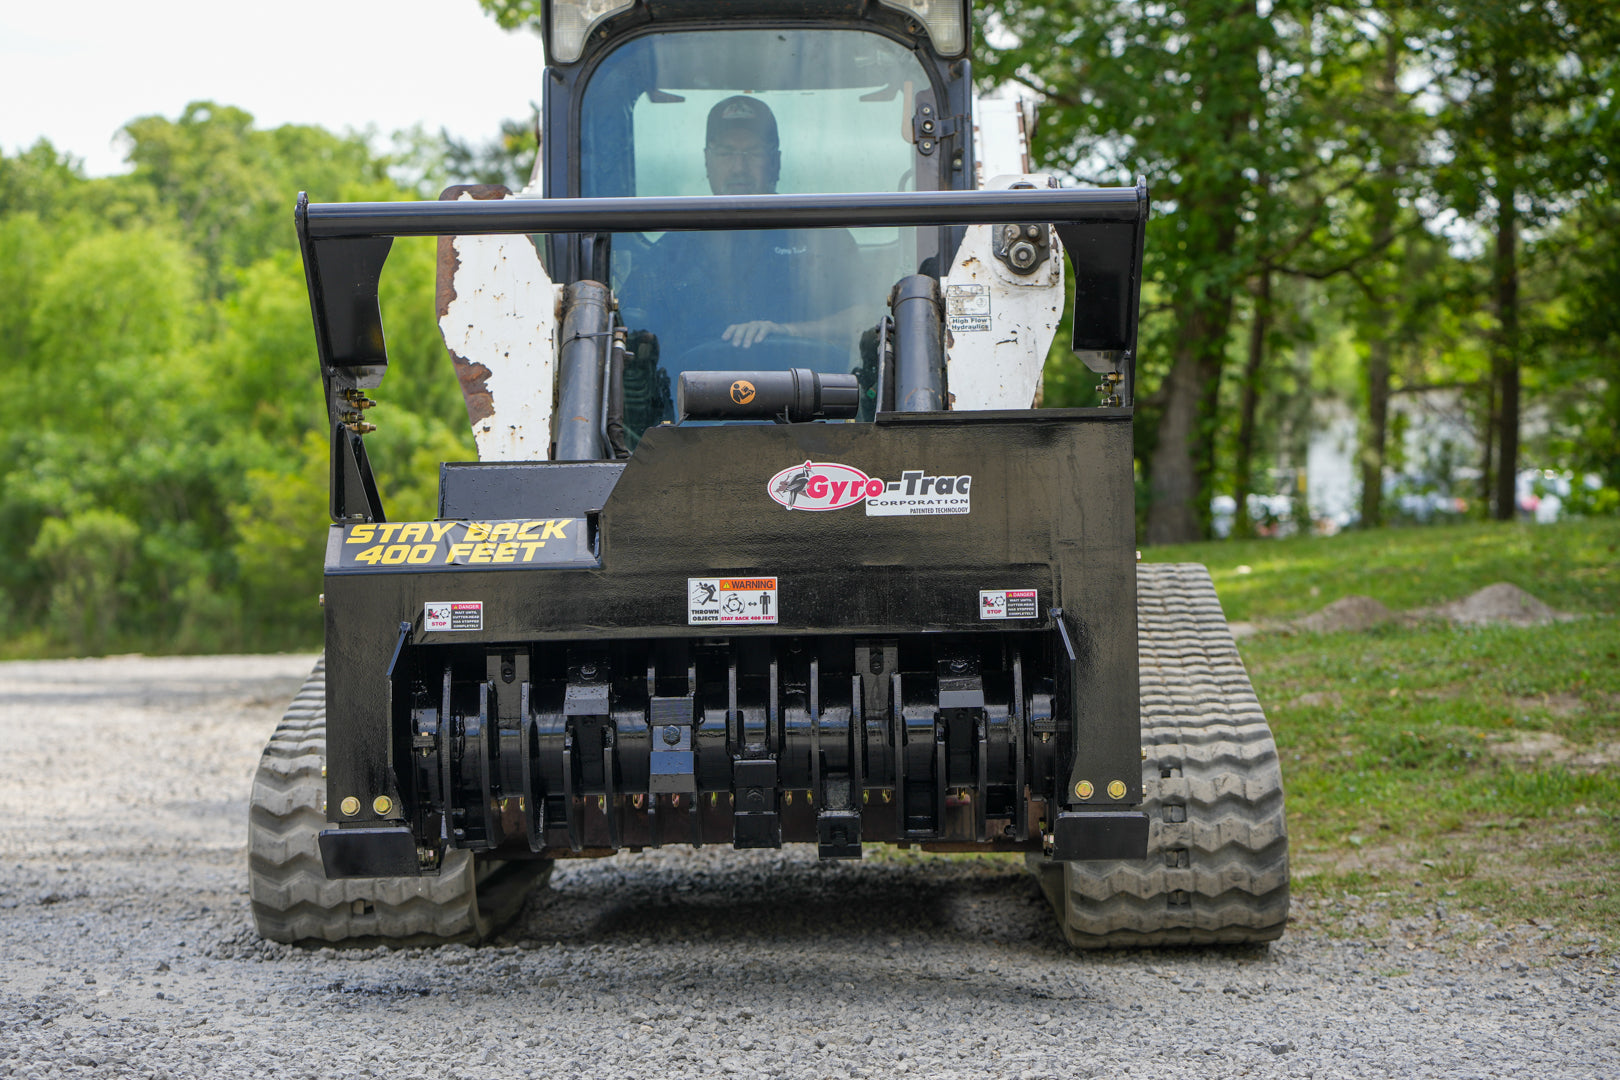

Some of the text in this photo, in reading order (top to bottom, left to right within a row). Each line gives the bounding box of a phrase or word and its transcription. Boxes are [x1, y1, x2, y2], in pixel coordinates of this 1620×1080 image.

[805, 471, 971, 505] Gyro-Trac
[345, 519, 574, 544] STAY BACK
[354, 541, 547, 565] 400 FEET
[731, 580, 773, 589] WARNING
